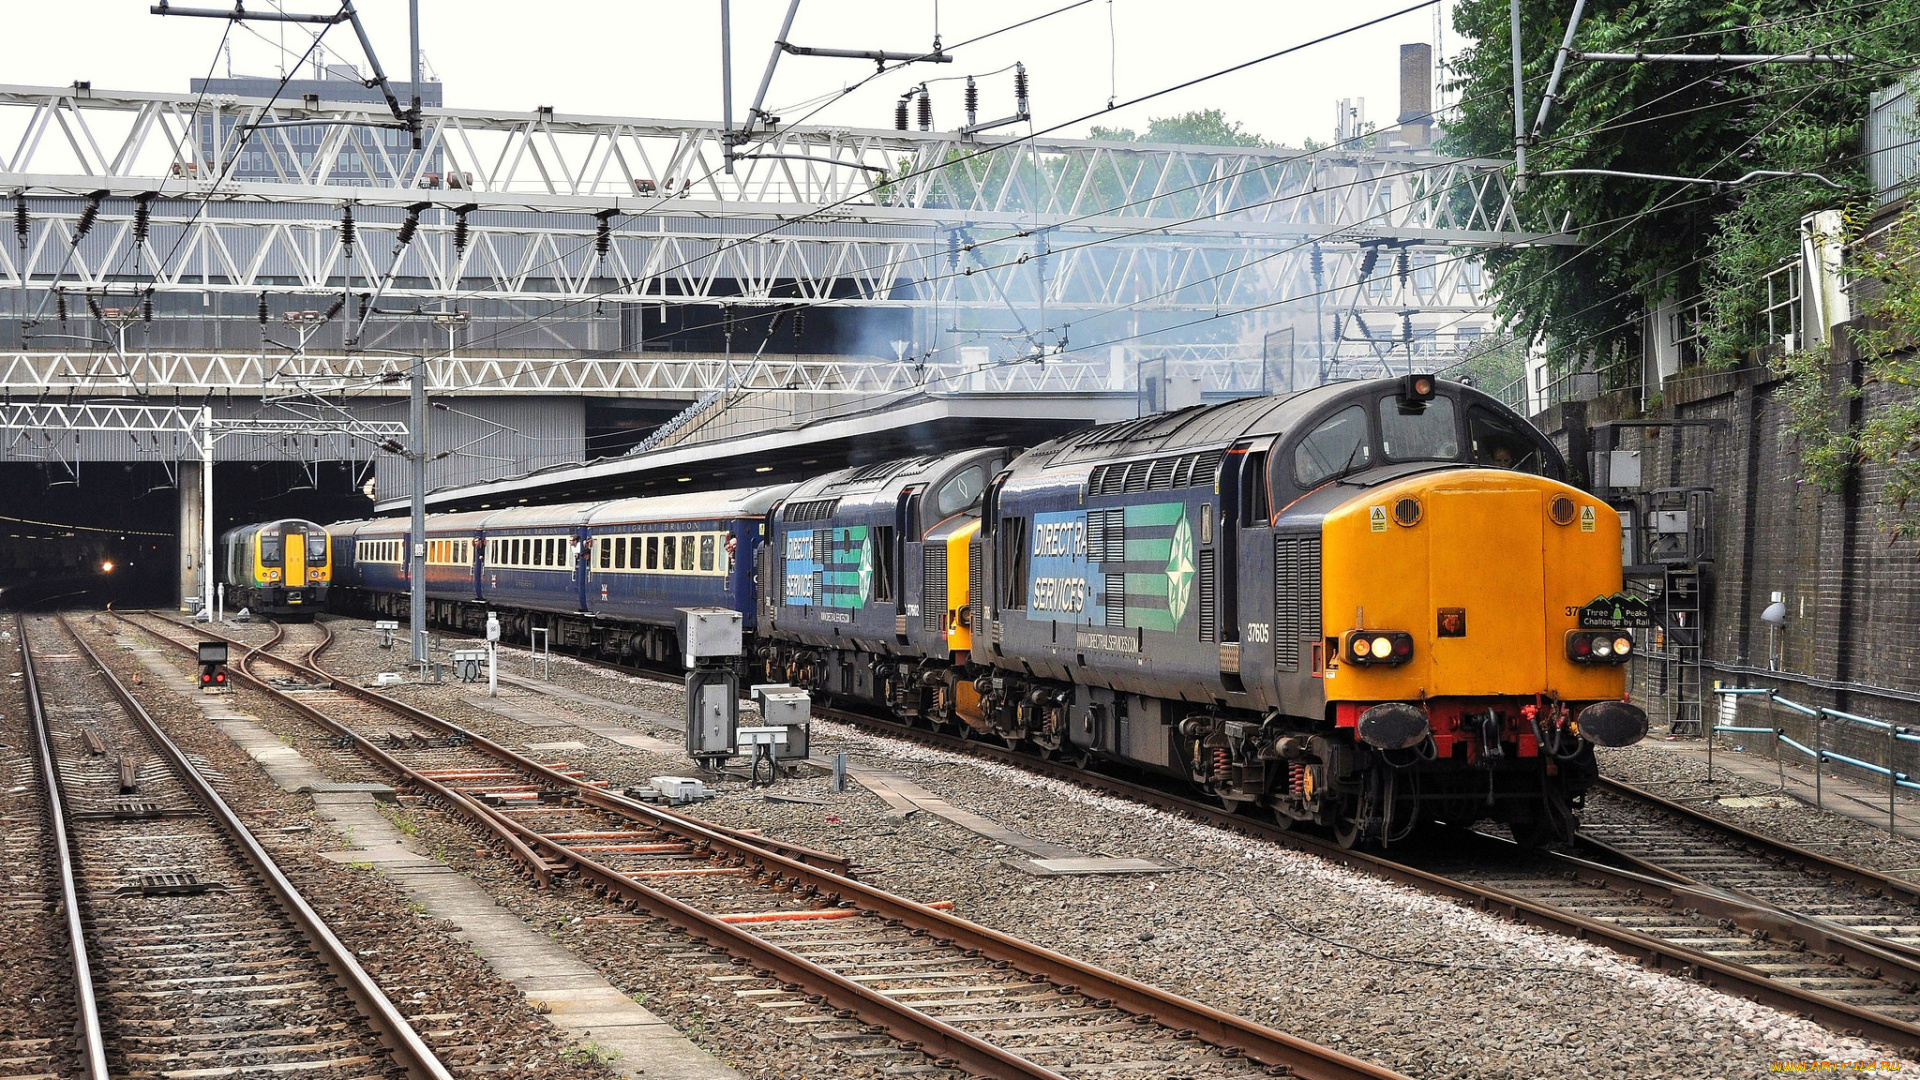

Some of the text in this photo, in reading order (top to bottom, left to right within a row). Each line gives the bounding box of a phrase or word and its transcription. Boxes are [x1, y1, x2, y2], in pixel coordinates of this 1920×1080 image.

[631, 524, 657, 532] GREAT
[787, 537, 809, 560] DIRECT
[1034, 522, 1074, 557] DIRECT
[1033, 577, 1085, 613] SERVICES
[1583, 618, 1620, 626] Challenge
[1625, 609, 1647, 617] Peaks
[1248, 622, 1269, 643] 37605
